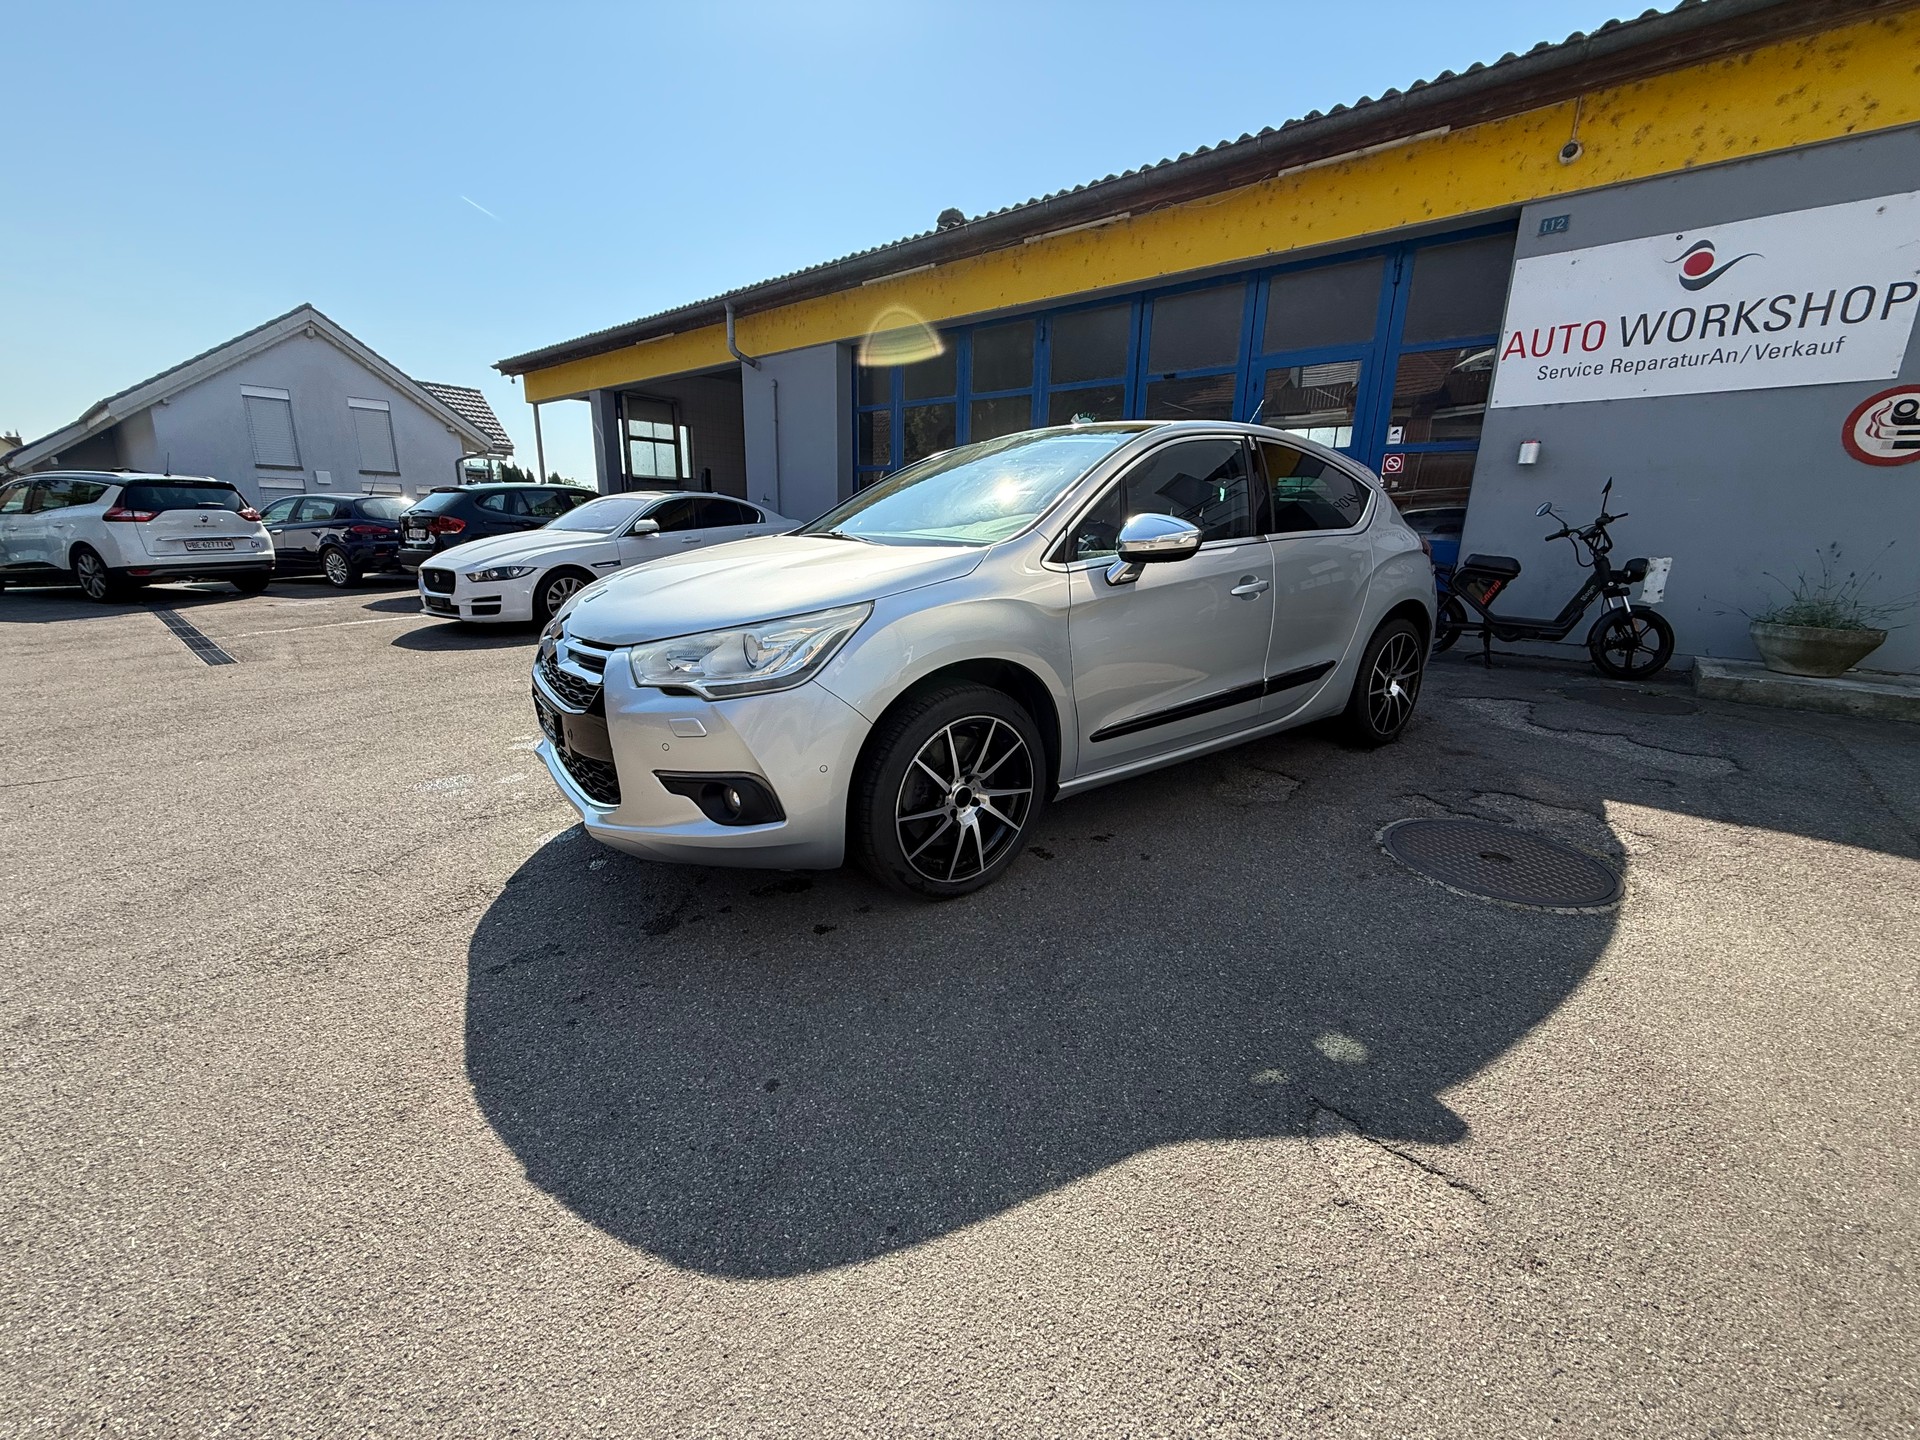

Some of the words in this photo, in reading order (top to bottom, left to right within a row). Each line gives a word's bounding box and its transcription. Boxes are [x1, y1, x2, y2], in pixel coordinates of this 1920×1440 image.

[1543, 218, 1565, 231] 112
[1501, 319, 1607, 361] AUTO
[1620, 281, 1918, 348] WORKSHOP
[1537, 362, 1604, 381] Service
[1609, 335, 1847, 375] ReparaturAn/Verkauf
